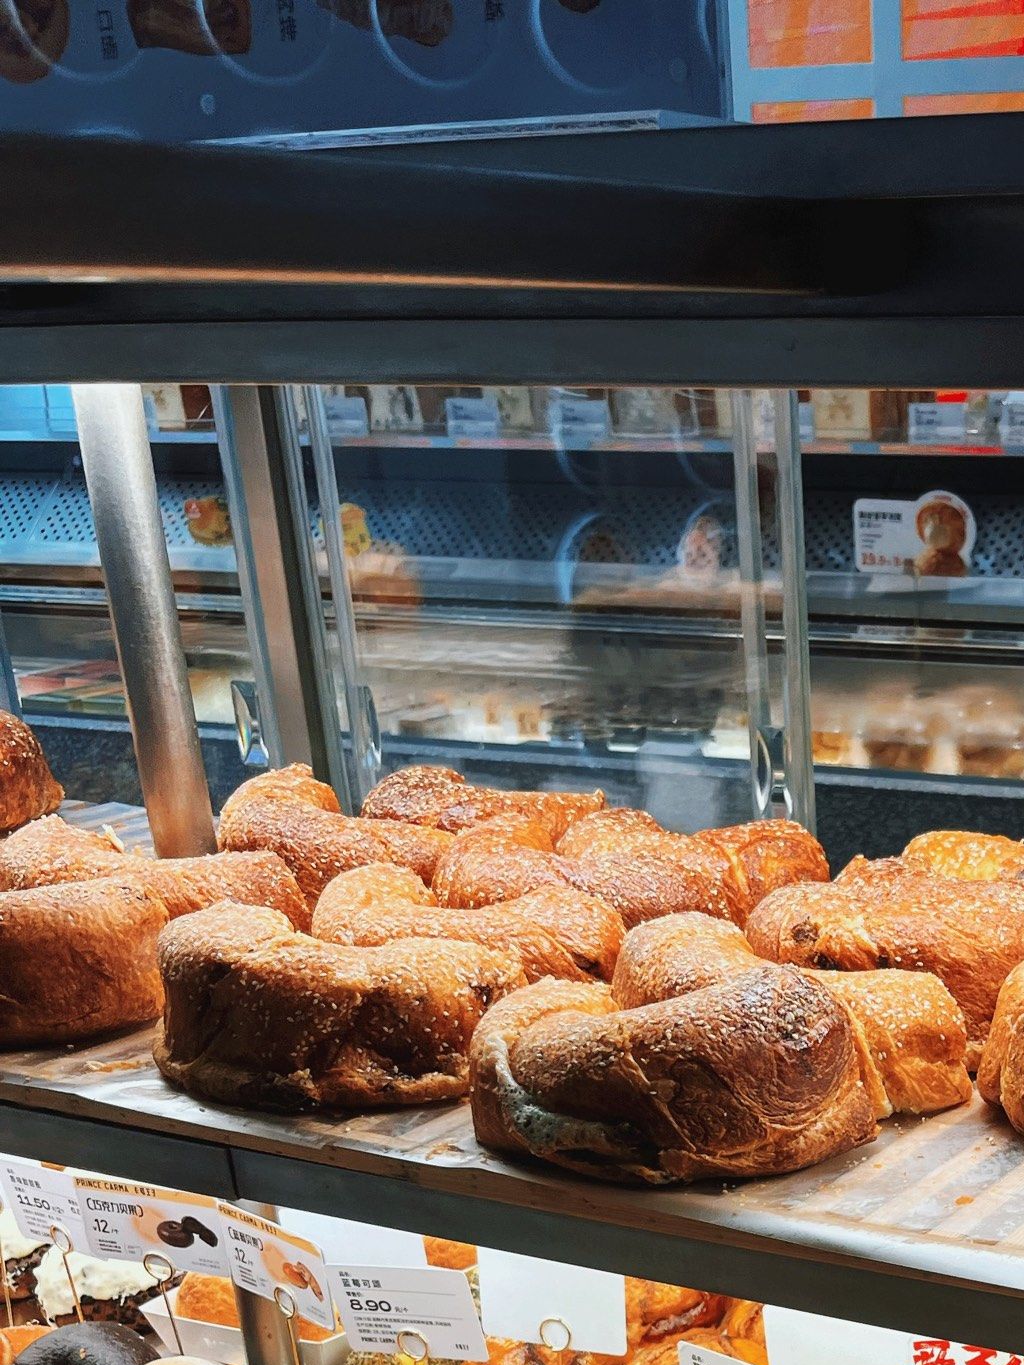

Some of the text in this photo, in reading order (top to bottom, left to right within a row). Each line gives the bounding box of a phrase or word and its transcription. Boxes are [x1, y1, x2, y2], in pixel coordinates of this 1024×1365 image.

[76, 1178, 102, 1190] PRINCE
[104, 1182, 129, 1193] CARMA
[350, 1299, 392, 1312] 8.90
